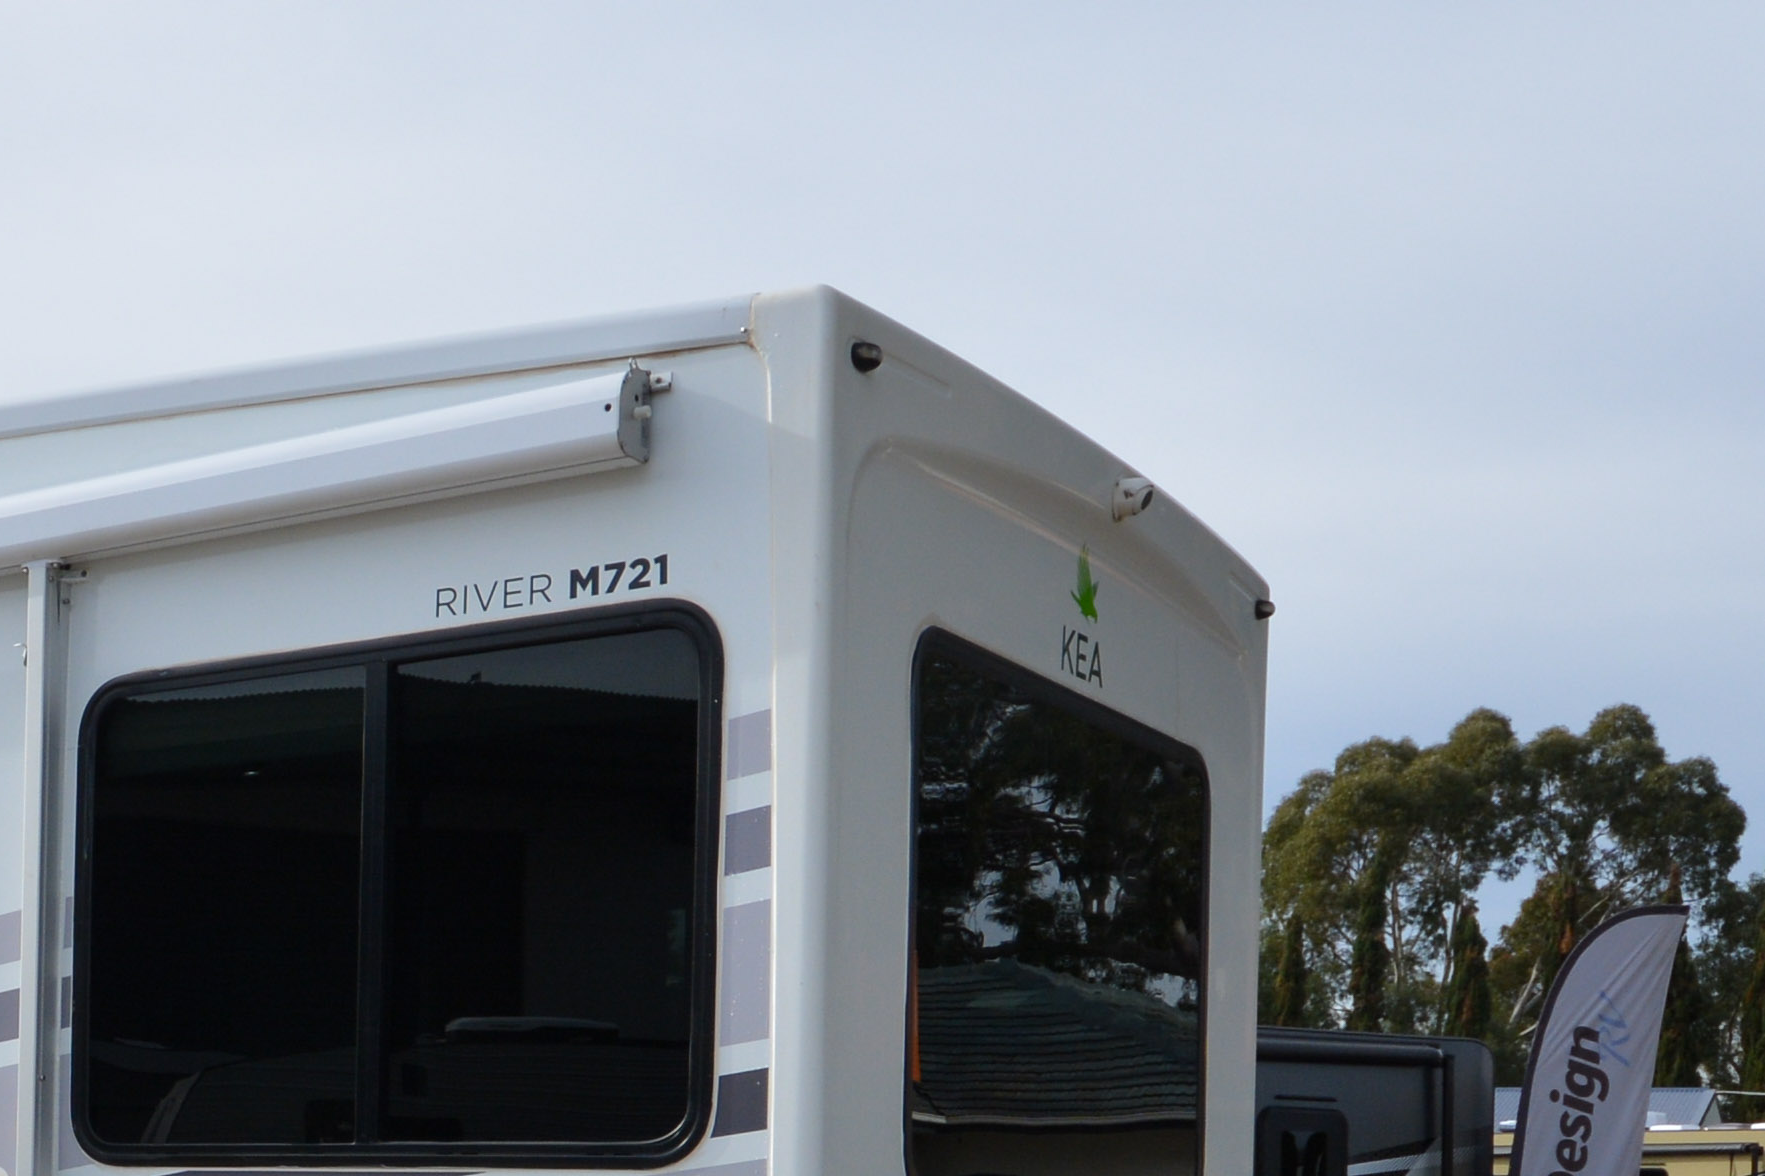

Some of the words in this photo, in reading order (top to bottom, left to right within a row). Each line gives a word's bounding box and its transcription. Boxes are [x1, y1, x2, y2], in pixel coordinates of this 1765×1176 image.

[435, 573, 553, 619] RIVER
[568, 553, 669, 600] M721
[1060, 624, 1103, 689] KEA
[1597, 990, 1631, 1067] RV
